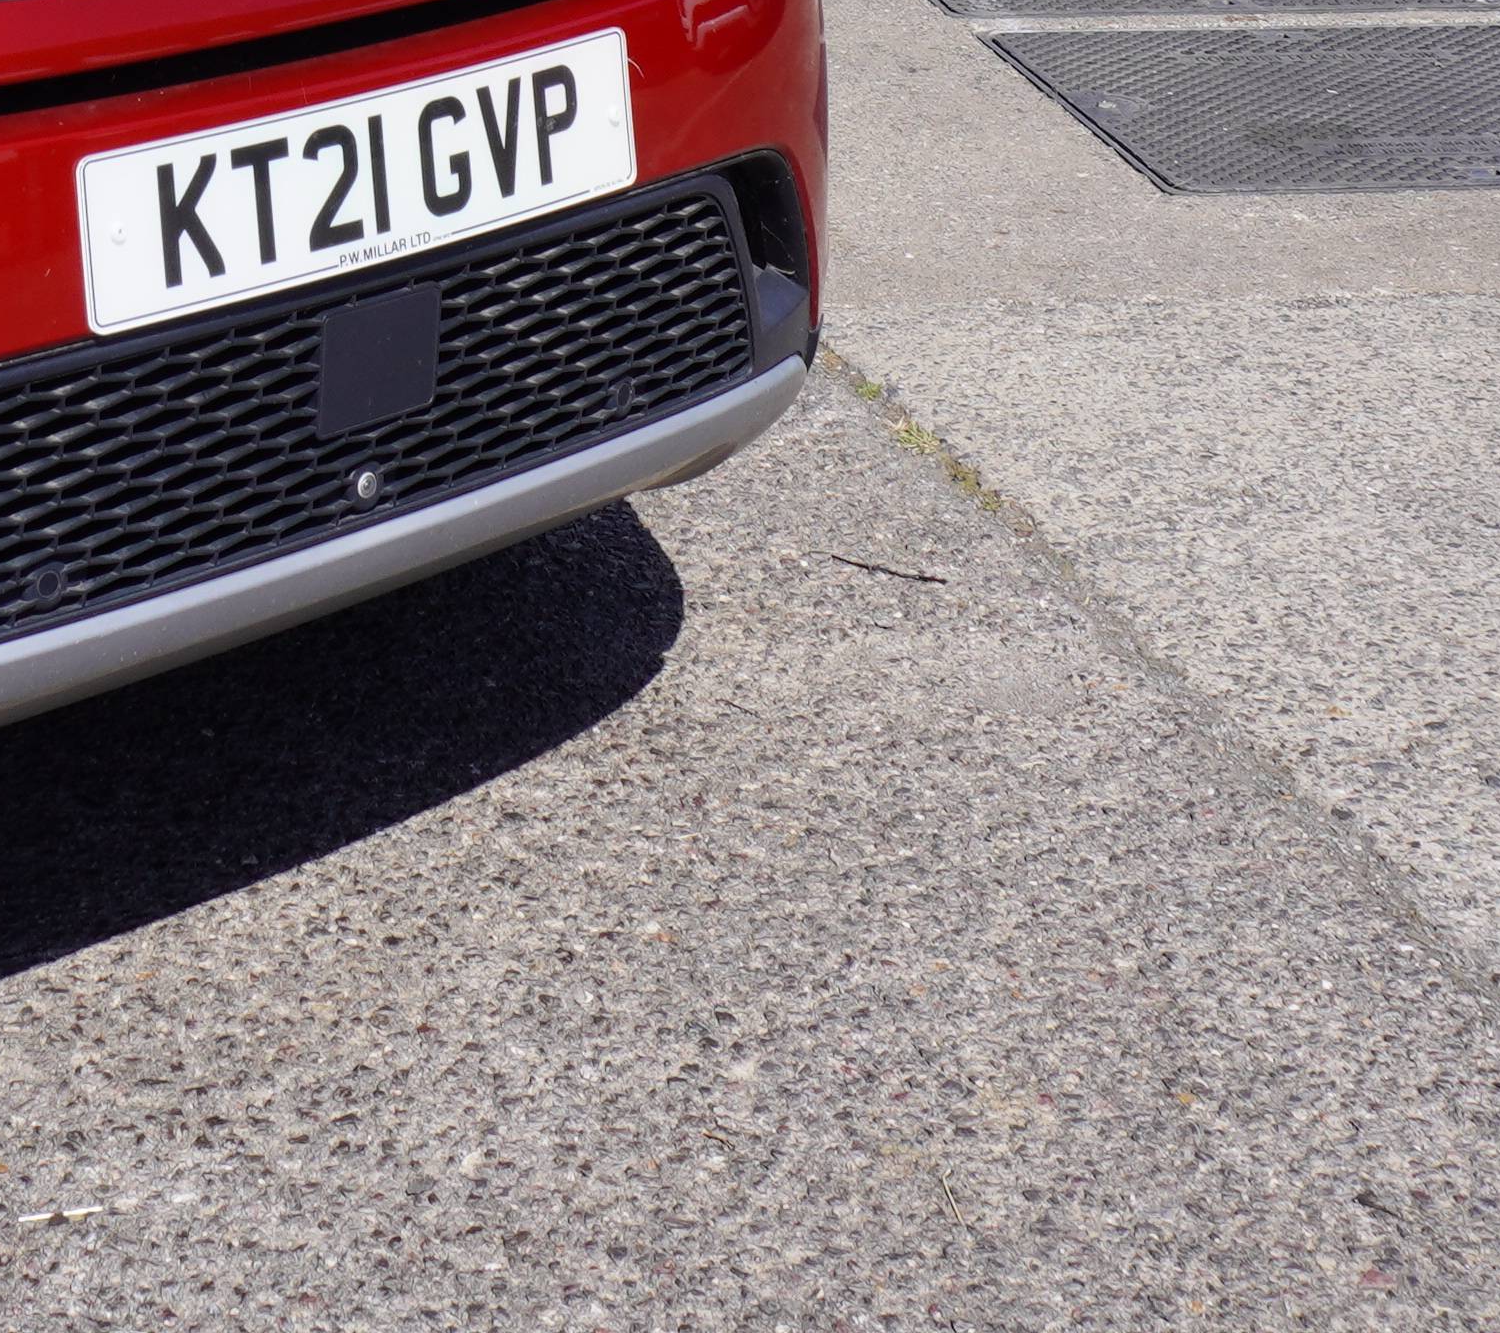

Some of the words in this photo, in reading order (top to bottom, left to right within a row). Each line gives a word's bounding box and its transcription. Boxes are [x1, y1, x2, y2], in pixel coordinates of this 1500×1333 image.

[157, 114, 392, 288] KT21
[418, 64, 577, 218] GVP
[410, 231, 431, 249] LTD
